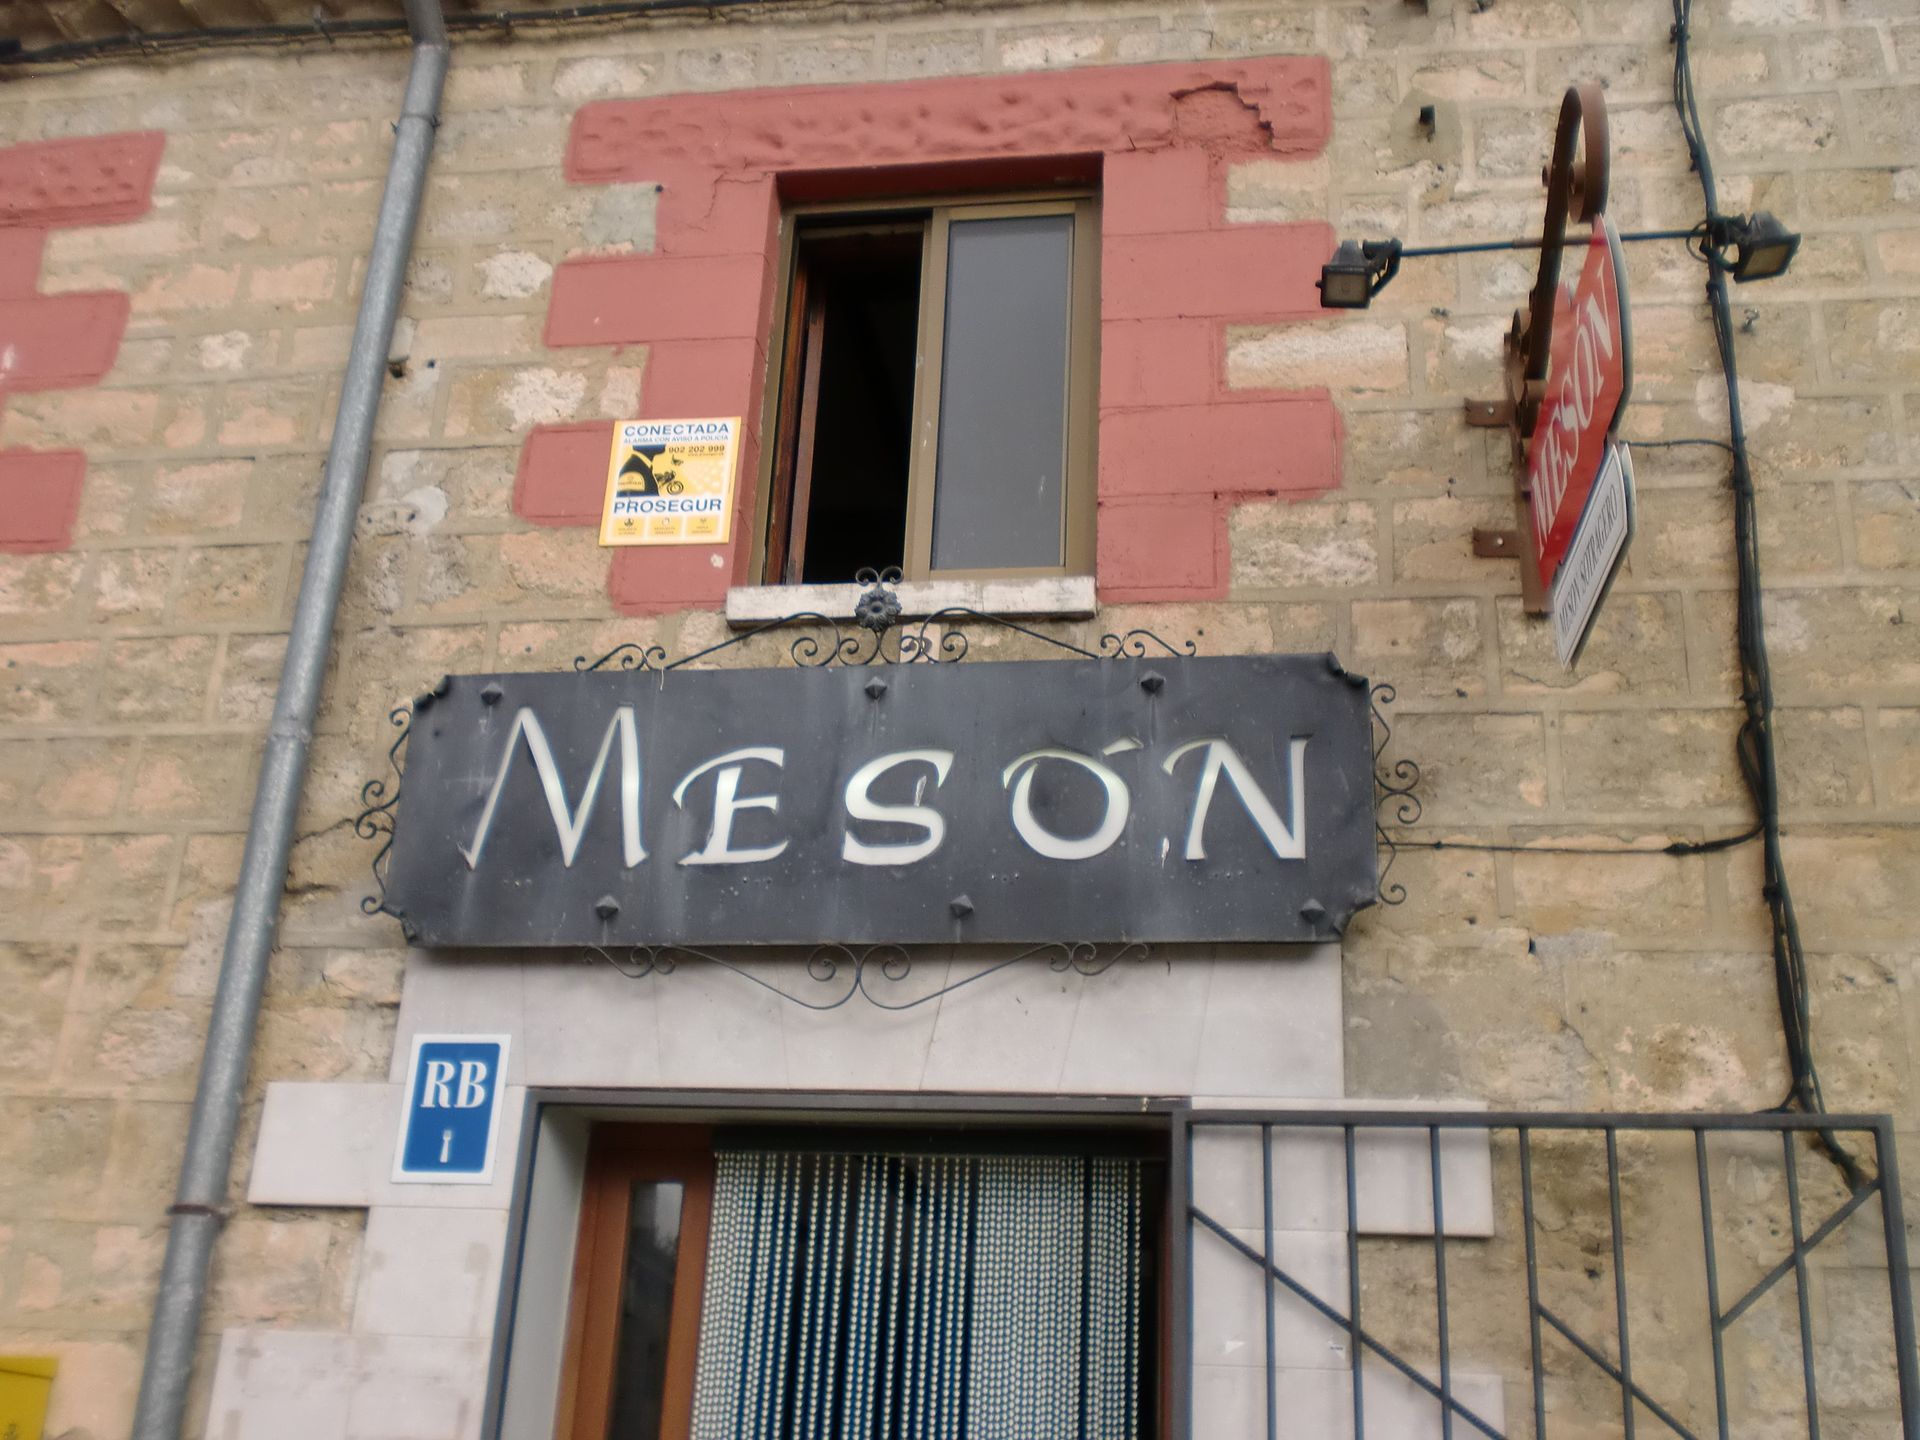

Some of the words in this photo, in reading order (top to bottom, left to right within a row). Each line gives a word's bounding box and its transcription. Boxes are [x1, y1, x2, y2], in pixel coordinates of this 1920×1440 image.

[624, 423, 729, 437] CONECTADA
[613, 499, 722, 513] PROSEGUR
[456, 704, 1314, 869] MESÓN
[420, 1060, 488, 1108] RB
